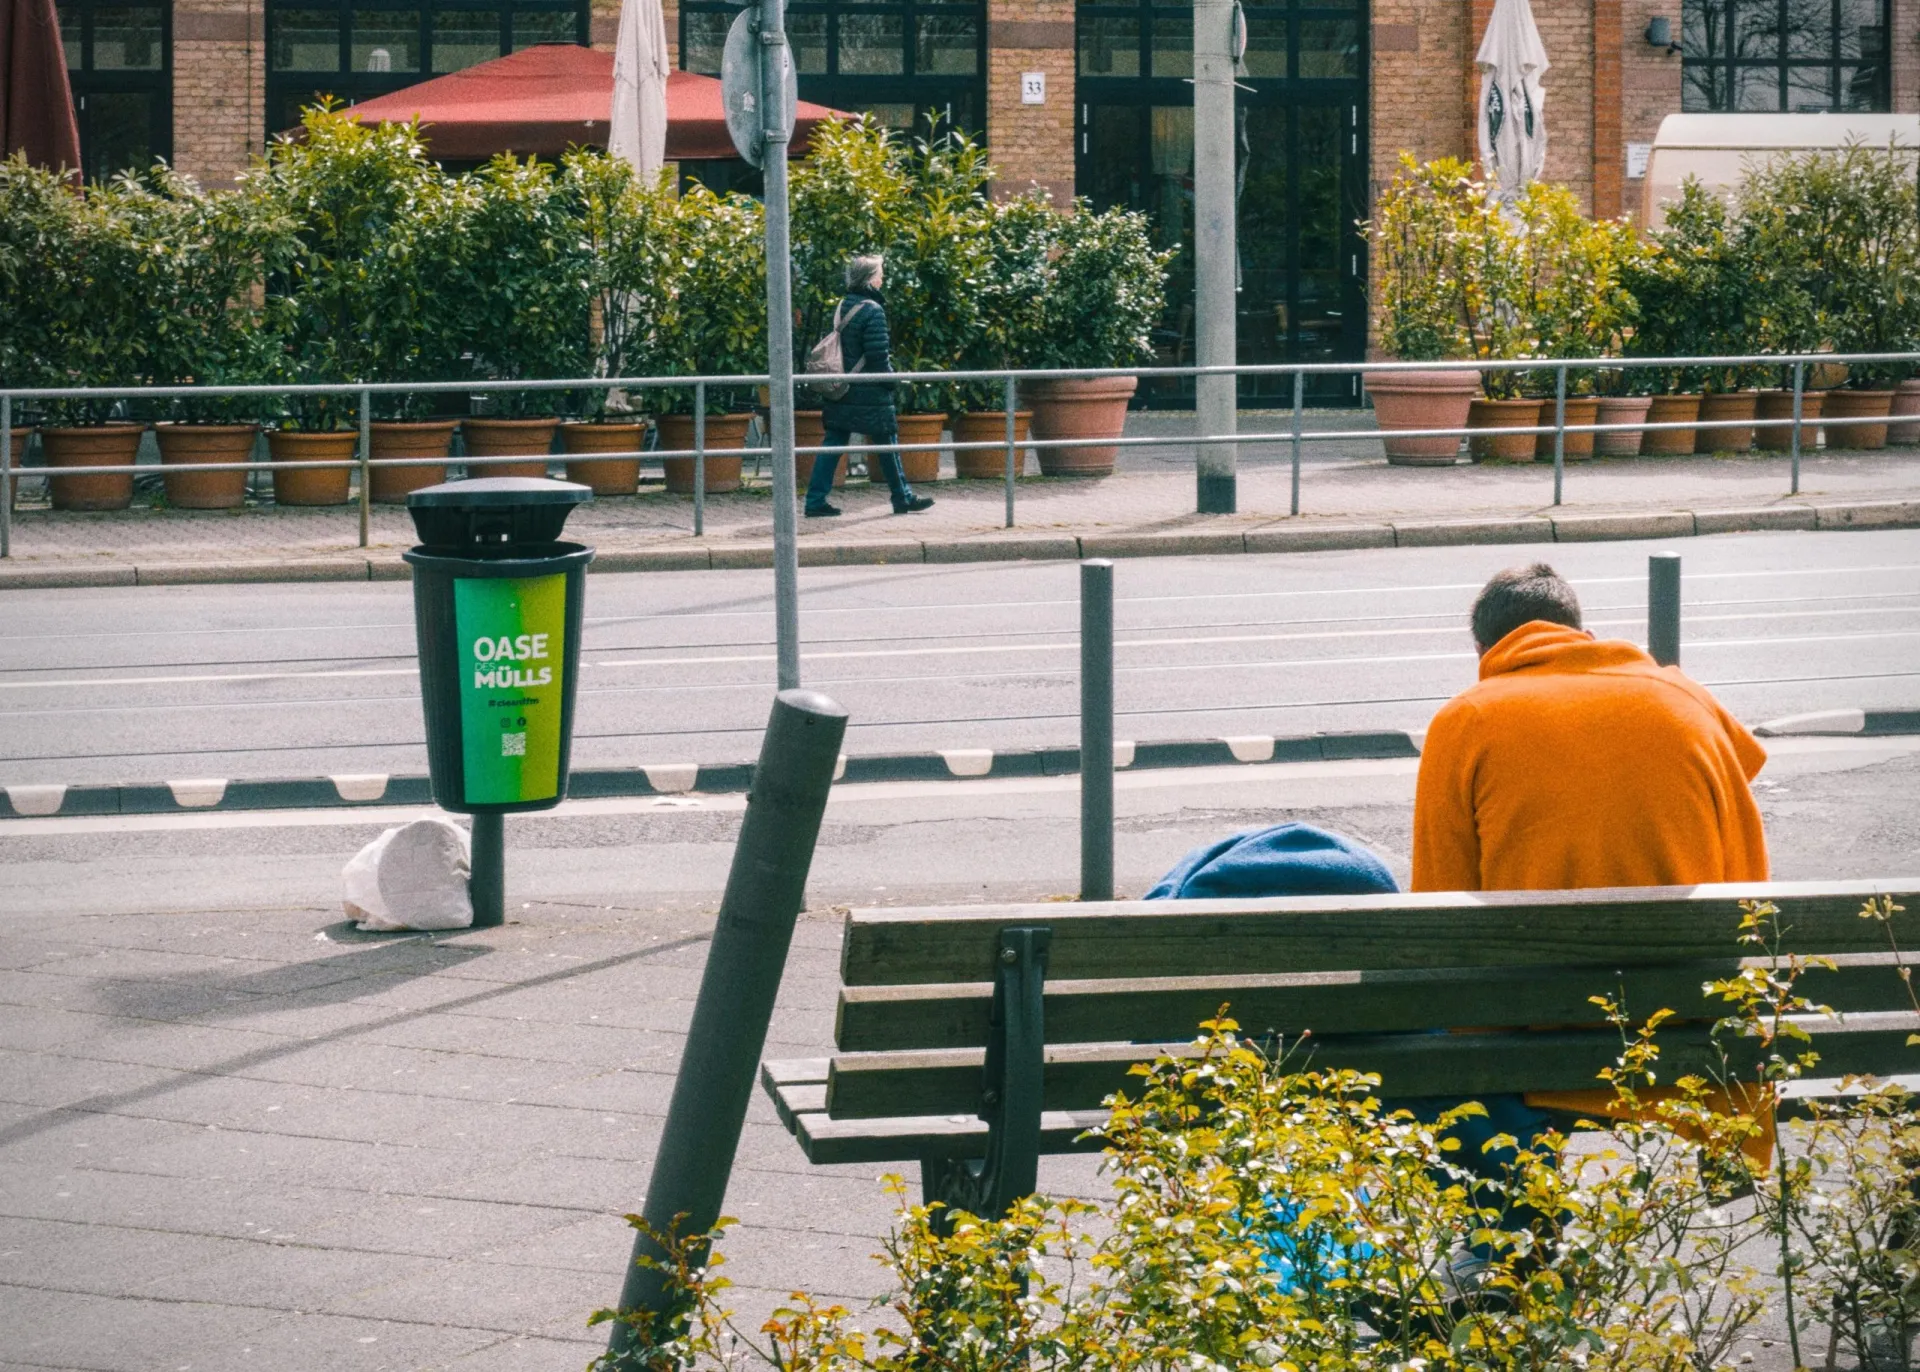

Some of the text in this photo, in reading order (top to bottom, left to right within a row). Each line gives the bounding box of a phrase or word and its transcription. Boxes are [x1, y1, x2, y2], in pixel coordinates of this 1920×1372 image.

[1025, 81, 1042, 95] 33
[473, 633, 549, 662] OASE
[474, 662, 496, 671] DES
[474, 665, 552, 689] MÜLLS
